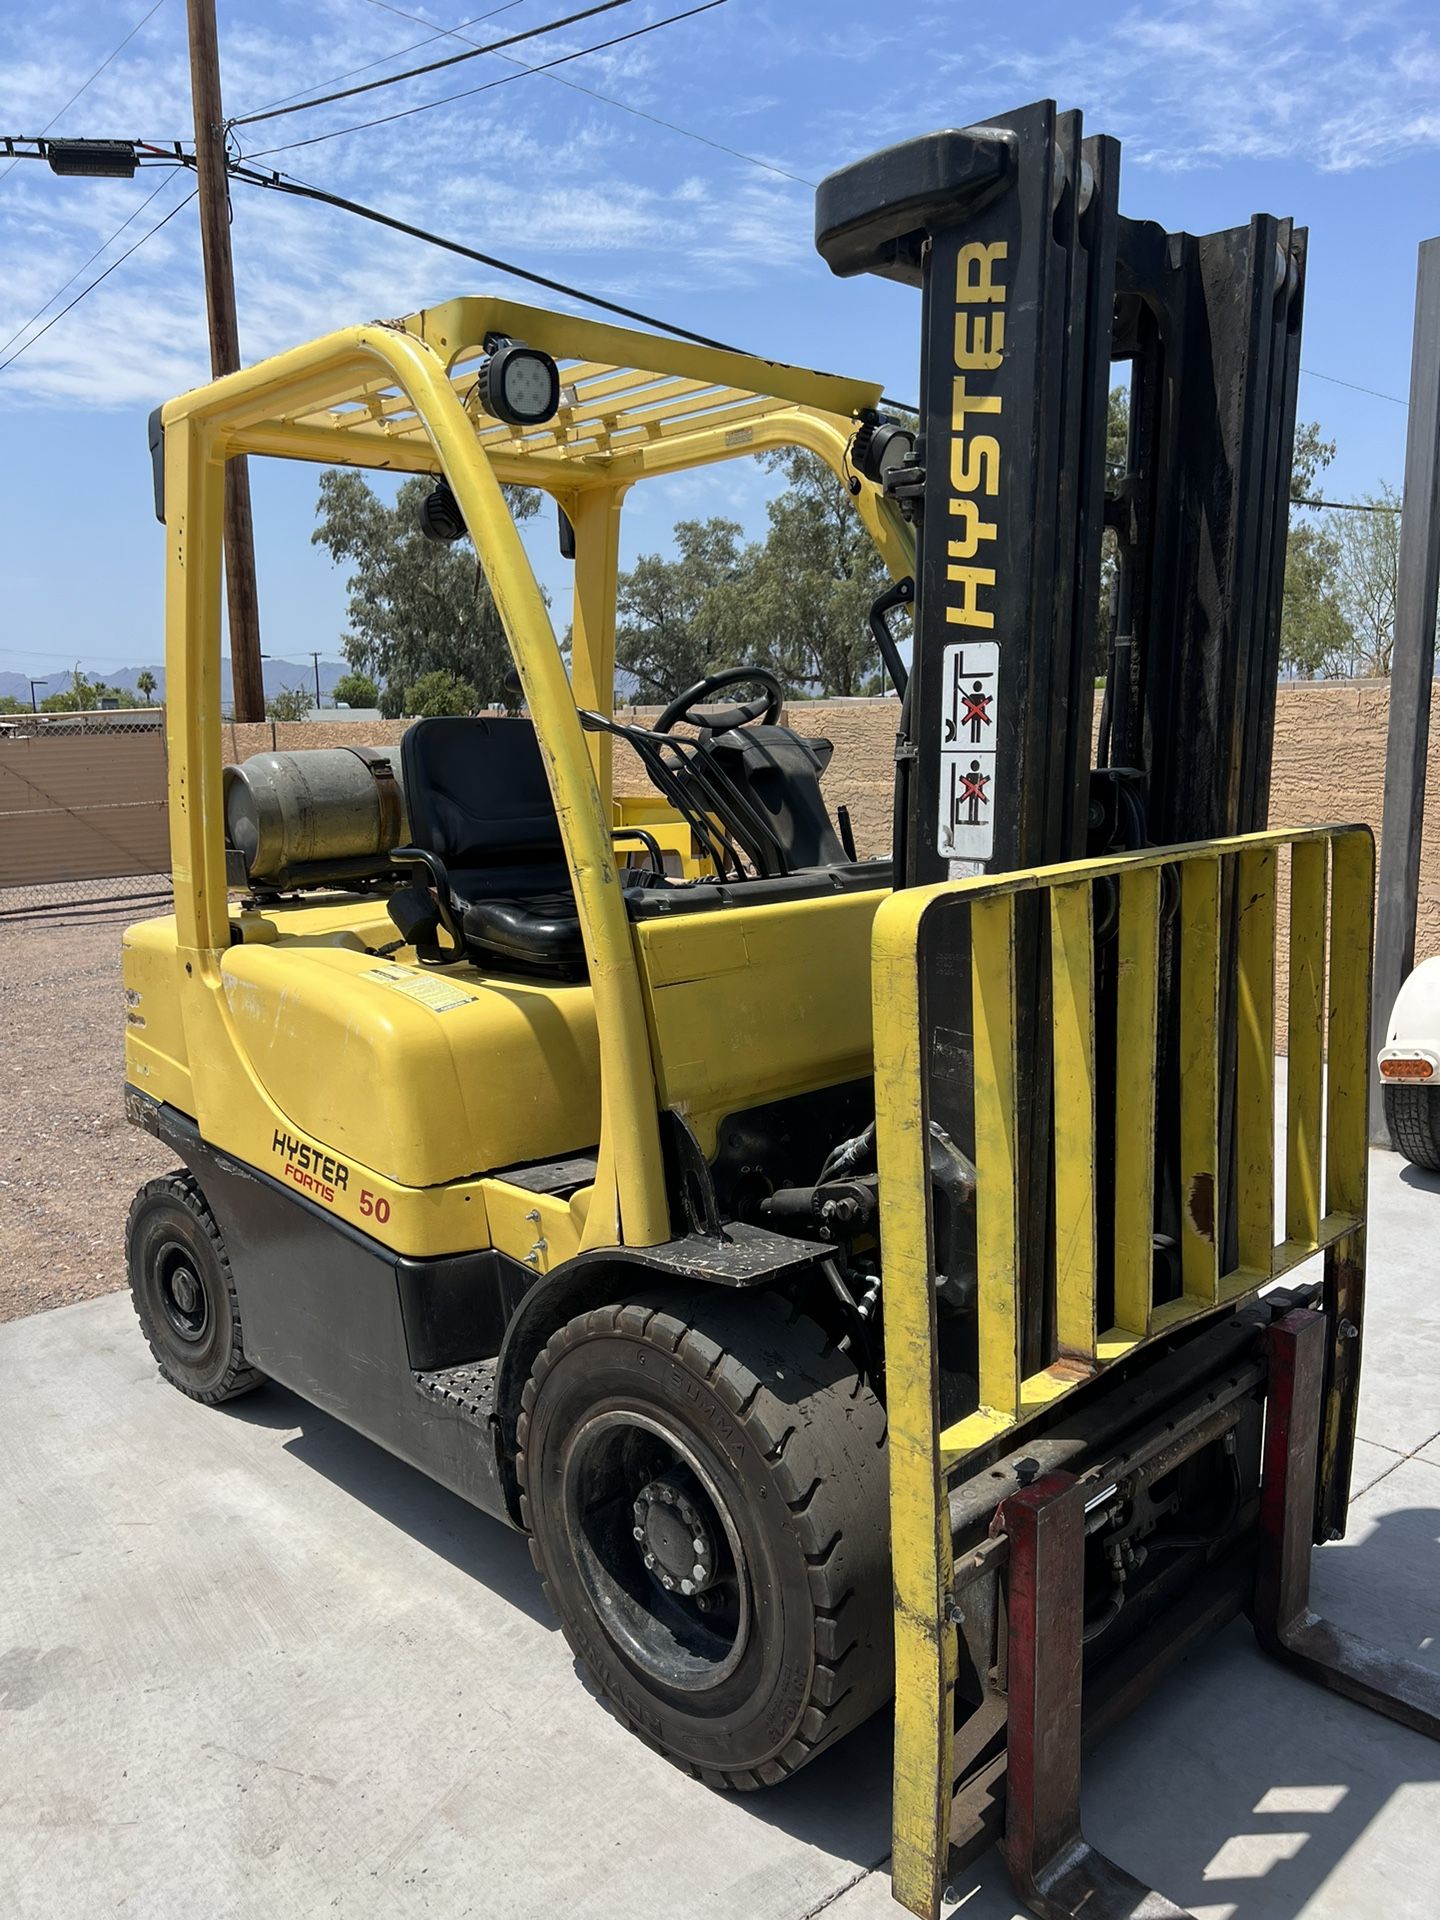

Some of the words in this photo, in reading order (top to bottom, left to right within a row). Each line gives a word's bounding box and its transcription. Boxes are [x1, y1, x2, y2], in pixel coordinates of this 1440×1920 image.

[946, 241, 1008, 629] HYSTER
[272, 1128, 349, 1191] HYSTER
[284, 1163, 335, 1203] FORTIS
[359, 1189, 390, 1224] 50
